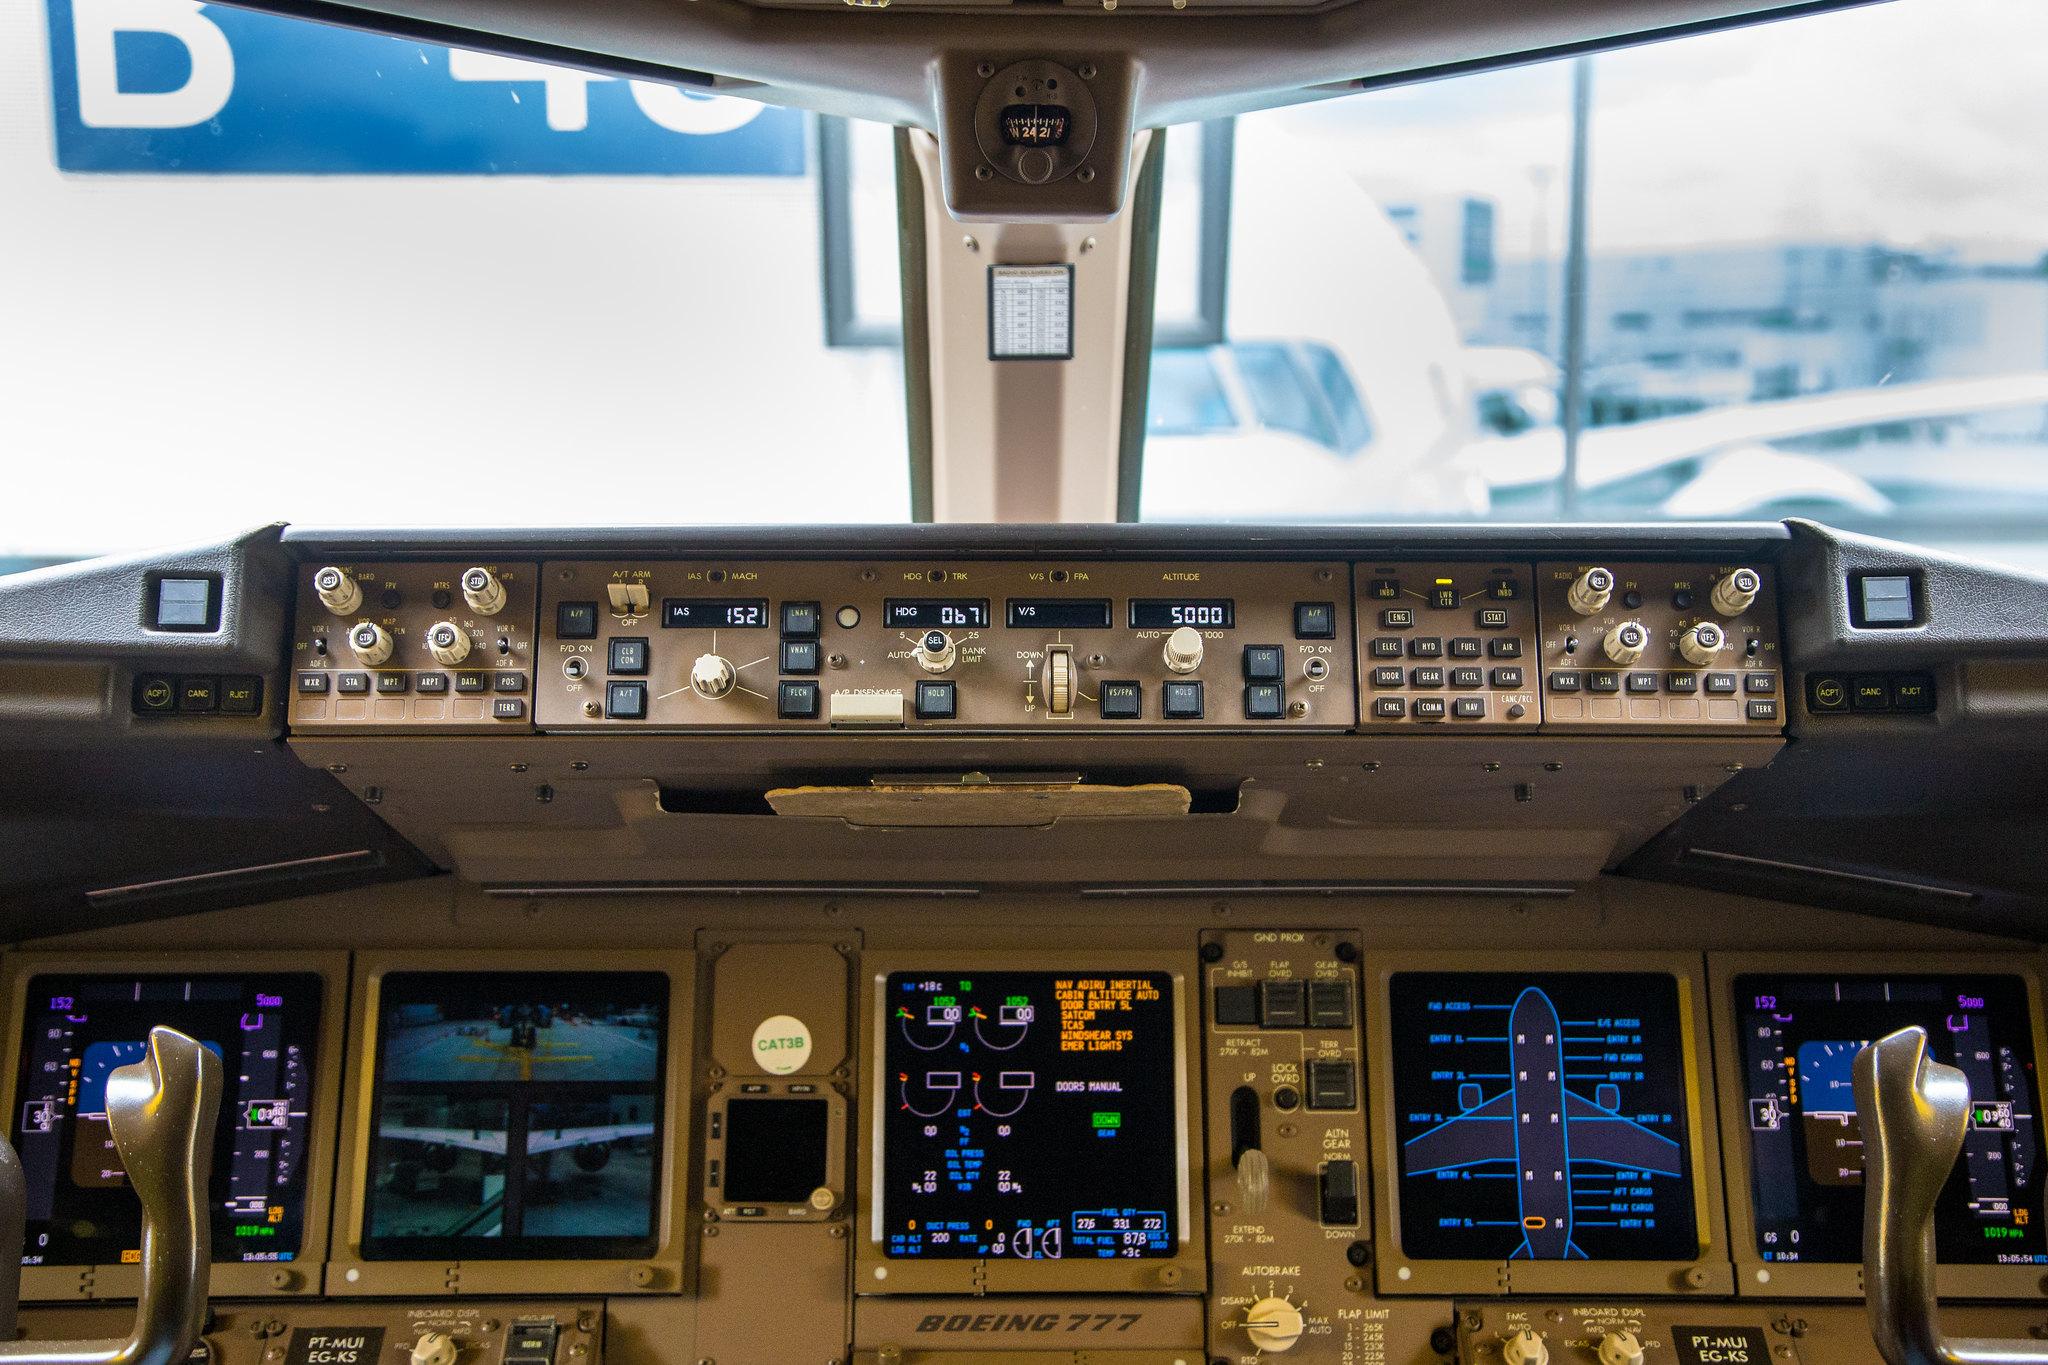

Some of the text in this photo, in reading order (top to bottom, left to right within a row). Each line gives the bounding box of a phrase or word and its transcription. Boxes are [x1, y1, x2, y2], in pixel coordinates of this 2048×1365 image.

[1022, 127, 1050, 138] 24 21
[1163, 573, 1200, 581] ALTITUDE
[673, 607, 689, 615] IAS
[895, 607, 917, 615] HDG
[1018, 607, 1035, 615] V/S
[1308, 609, 1321, 617] A/P
[726, 607, 758, 624] 152
[1171, 607, 1223, 624] 5000
[1393, 613, 1406, 621] ENG
[1487, 613, 1502, 621] STAT
[1137, 631, 1160, 639] AUTO
[1204, 631, 1224, 639] 1000
[927, 636, 943, 644] SEL
[517, 642, 528, 650] OFF
[1382, 642, 1397, 650] ELEC
[1422, 642, 1436, 650] HYD
[1502, 643, 1514, 651] AIR
[1545, 641, 1556, 649] OFF
[621, 647, 634, 655] CLB
[1016, 651, 1044, 659] DOWN
[620, 656, 634, 664] CON
[962, 655, 982, 663] LIMIT
[1381, 672, 1399, 680] DOOR
[1422, 672, 1439, 680] GEAR
[304, 678, 320, 686] WXR
[345, 678, 358, 686] STA
[384, 678, 398, 686] WPT
[421, 678, 439, 686] ARPT
[461, 678, 477, 686] DATA
[502, 678, 515, 686] POS
[1600, 677, 1612, 685] STA
[1675, 678, 1692, 686] ARPT
[1715, 678, 1731, 686] DATA
[1755, 679, 1769, 687] POS
[566, 684, 583, 692] OFF
[1175, 688, 1193, 696] HOLD
[1308, 685, 1324, 693] OFF
[147, 689, 167, 697] ACPT
[927, 689, 945, 697] HOLD
[1820, 689, 1839, 697] ACPT
[1501, 694, 1533, 704] CANC/RCL
[498, 703, 516, 713] TERR
[1384, 703, 1400, 711] CHKL
[1422, 703, 1442, 711] COMM
[1465, 703, 1478, 711] NAV
[1756, 705, 1772, 713] TERR
[1254, 933, 1304, 942] GND PROX
[1055, 981, 1073, 990] NAV
[1110, 981, 1153, 990] INERTIAL
[1055, 991, 1159, 1000] CABIN ALTITUDE AUTO
[50, 997, 74, 1010] 152
[1061, 1001, 1084, 1010] DOOR
[1089, 1001, 1116, 1010] ENTRY
[1754, 996, 1777, 1009] 152
[1957, 995, 1984, 1008] 5000
[1061, 1011, 1095, 1020] SATCOM
[1062, 1021, 1084, 1030] TCAS
[1061, 1031, 1133, 1040] WINDSHEAR SYS
[757, 1037, 804, 1051] CAT3B
[1061, 1041, 1122, 1051] EMER LIGHTS
[1226, 1039, 1261, 1047] RETRACT
[1272, 1064, 1297, 1073] LOCK
[1244, 1074, 1256, 1082] UP
[1271, 1074, 1300, 1083] OVRD
[1056, 1081, 1122, 1091] DOORS MANUAL
[1096, 1115, 1118, 1124] DOWN
[1325, 1129, 1349, 1138] ALTN
[1323, 1139, 1351, 1149] GEAR
[1233, 1226, 1265, 1234] EXTEND
[1984, 1227, 2008, 1238] 1019
[932, 1233, 949, 1243] 200
[1325, 1230, 1355, 1239] DOWN
[1242, 1266, 1301, 1276] AUTOBRAKE
[1338, 1309, 1390, 1319] FLAP LIMIT
[1573, 1308, 1646, 1316] INBOARD DSPL
[915, 1314, 1142, 1333] BOEING 777
[1221, 1321, 1236, 1329] OFF
[1309, 1317, 1329, 1325] MAX
[1309, 1326, 1332, 1334] AUTO
[308, 1337, 364, 1349] PT-MUI
[1692, 1336, 1748, 1349] PT-MUI
[308, 1351, 358, 1363] EG-KS
[1699, 1350, 1749, 1363] EG-KS
